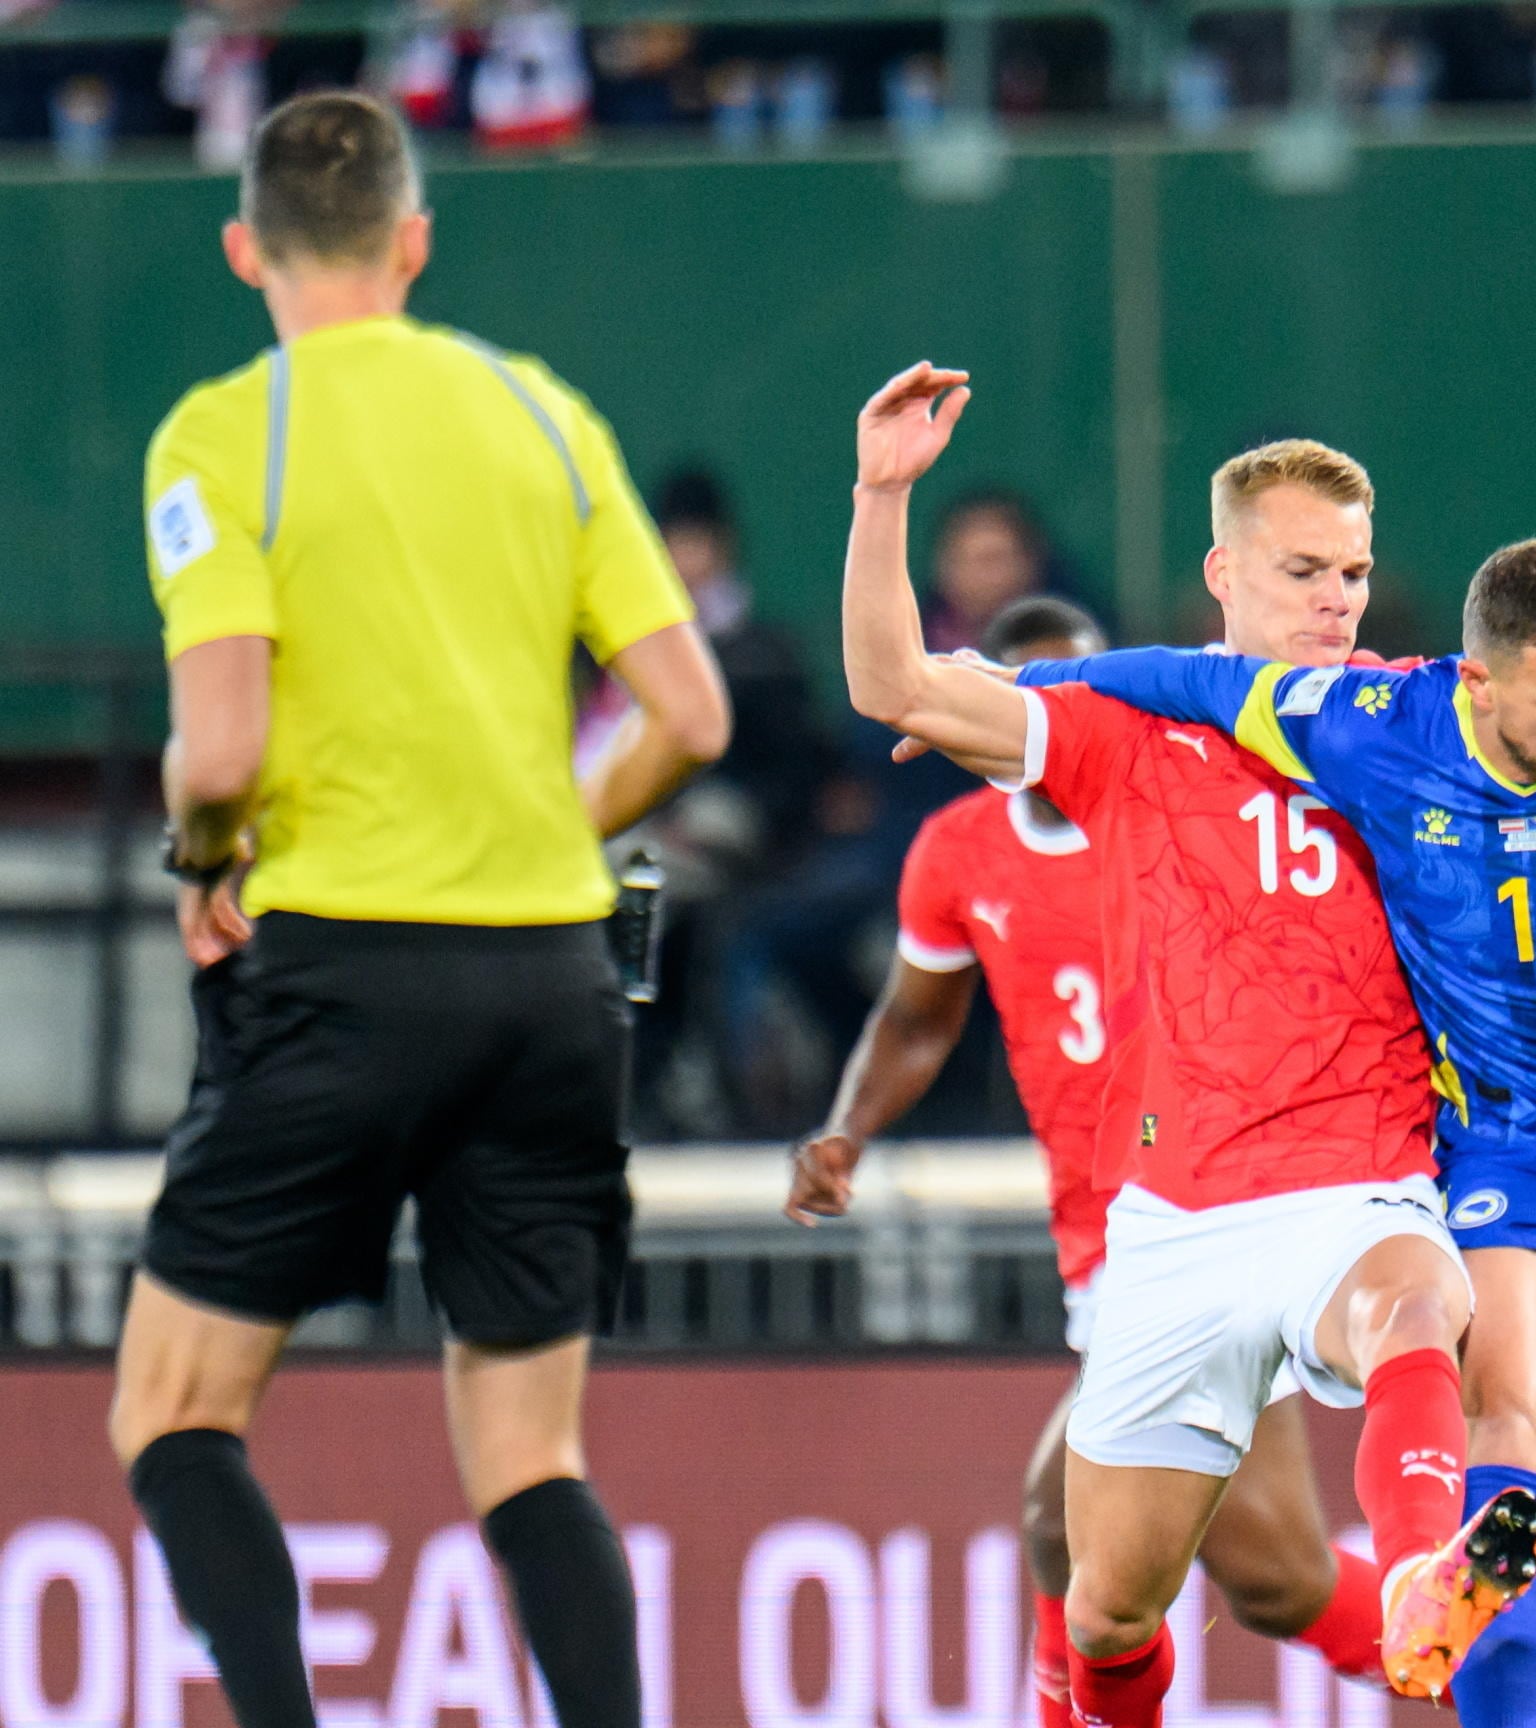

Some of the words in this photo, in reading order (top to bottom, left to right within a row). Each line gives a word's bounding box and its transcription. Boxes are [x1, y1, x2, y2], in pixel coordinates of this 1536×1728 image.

[1238, 789, 1338, 897] 15
[1414, 830, 1461, 847] KELME
[1052, 965, 1107, 1065] 3
